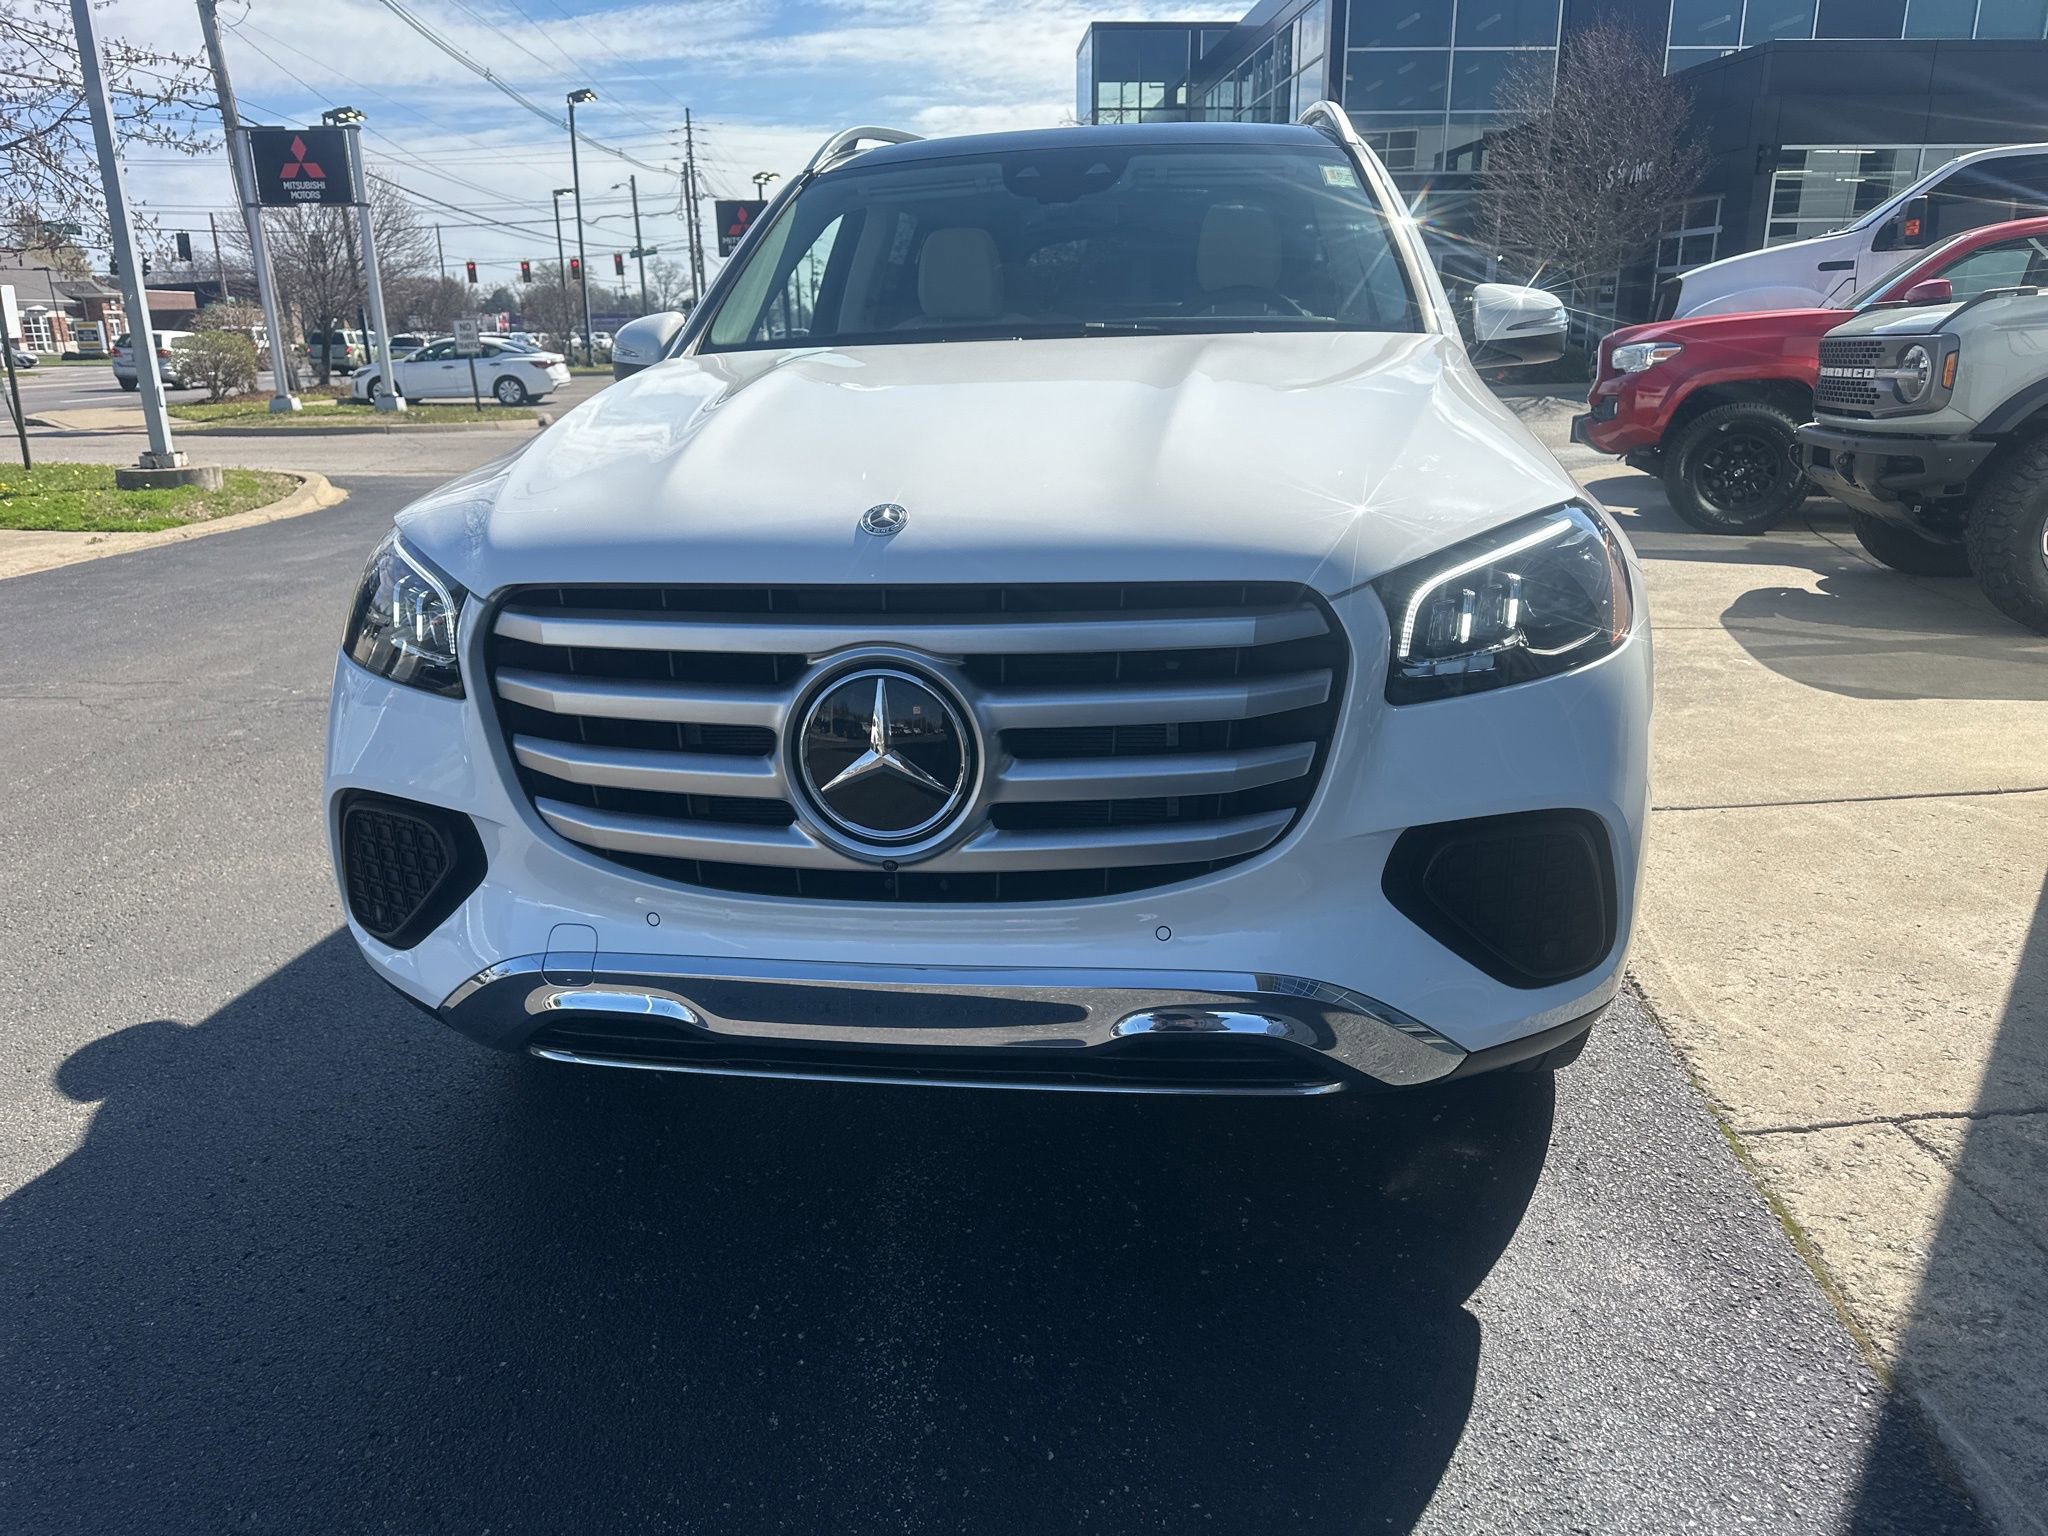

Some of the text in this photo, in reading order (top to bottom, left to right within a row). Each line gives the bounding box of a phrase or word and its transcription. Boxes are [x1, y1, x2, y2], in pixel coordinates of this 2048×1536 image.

[283, 181, 326, 190] MITSUBISHI
[290, 190, 321, 199] MOTORS
[459, 322, 472, 331] NO
[1820, 367, 1876, 378] BRONCO
